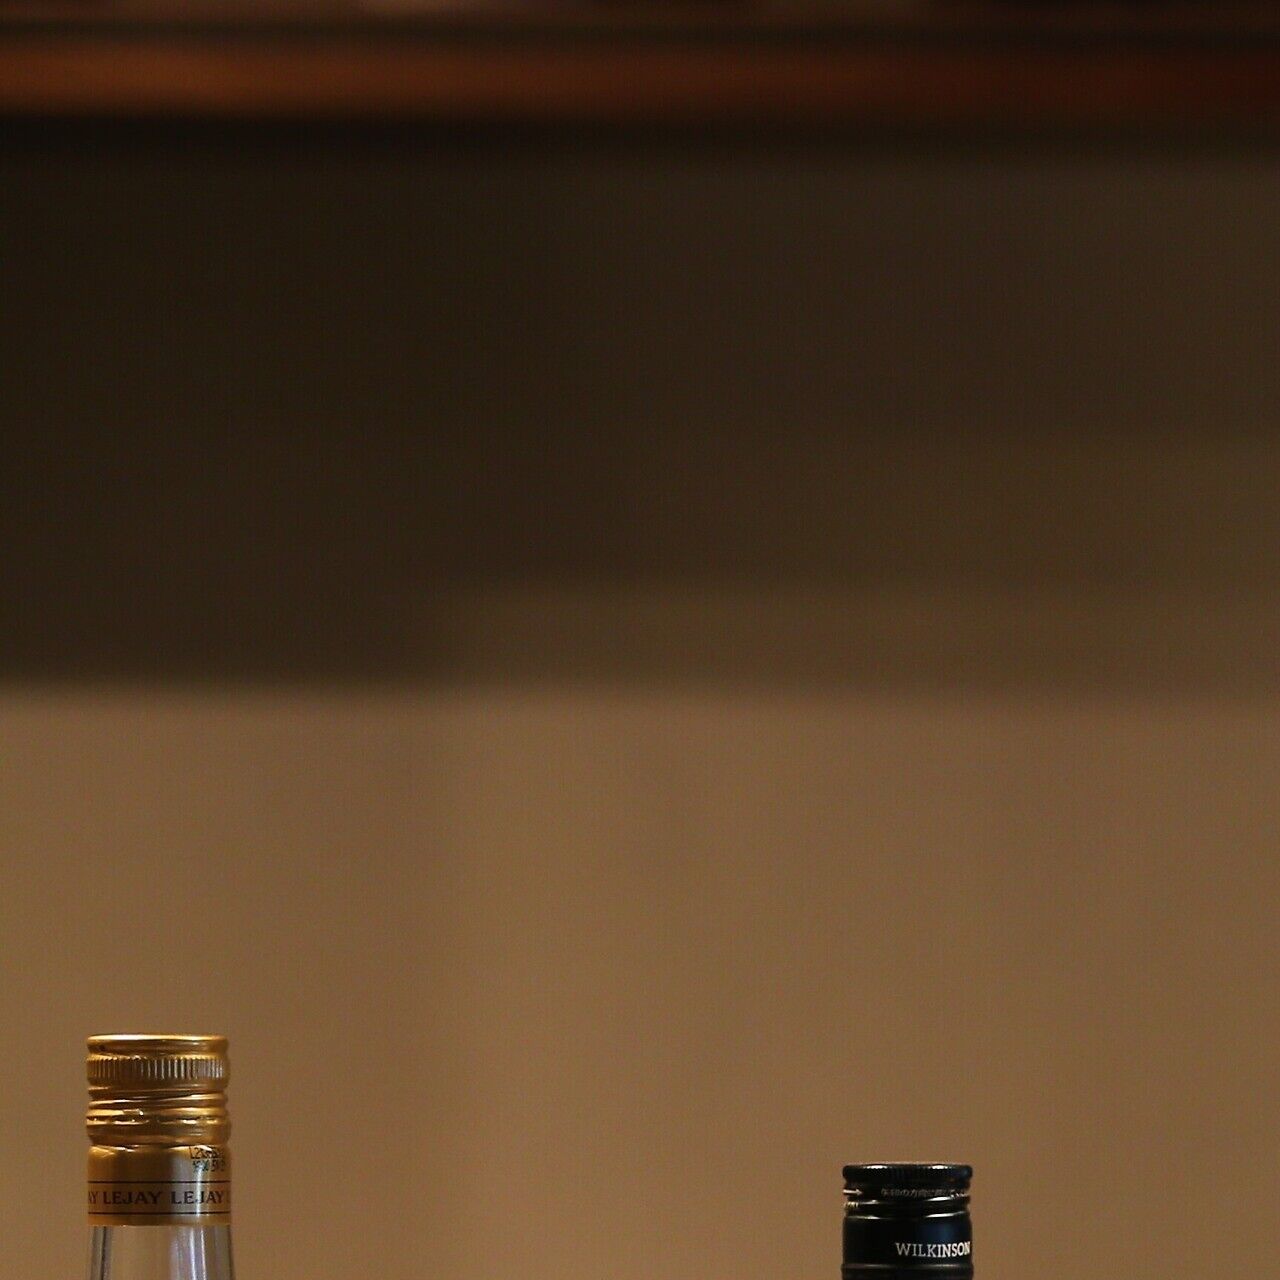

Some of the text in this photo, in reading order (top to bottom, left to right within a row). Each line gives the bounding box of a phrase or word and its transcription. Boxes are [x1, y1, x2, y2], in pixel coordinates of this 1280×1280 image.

[102, 1190, 223, 1204] LEJAY LEJAY
[895, 1240, 971, 1258] WILKINSON
